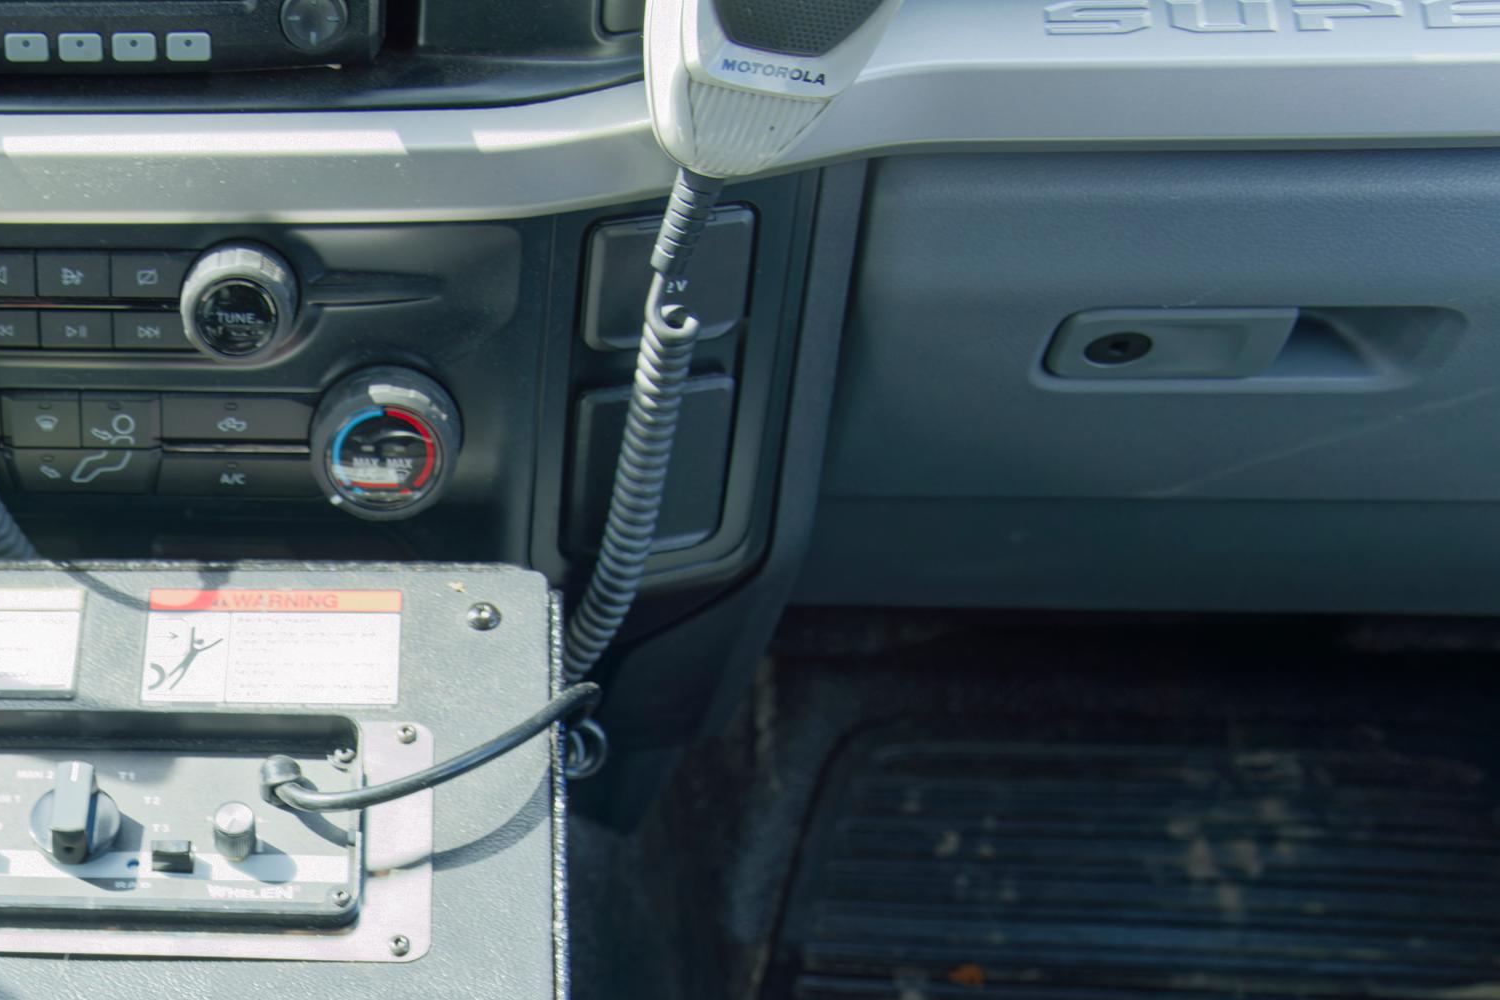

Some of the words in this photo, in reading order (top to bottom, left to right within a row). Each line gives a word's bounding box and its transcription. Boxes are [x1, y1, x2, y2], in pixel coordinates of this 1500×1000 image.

[721, 58, 826, 86] MOTOROLA
[216, 311, 255, 324] TUNE
[220, 473, 246, 485] A/C
[232, 593, 339, 609] WARNING
[118, 771, 136, 781] T1
[143, 796, 162, 806] T2
[152, 823, 170, 832] T3
